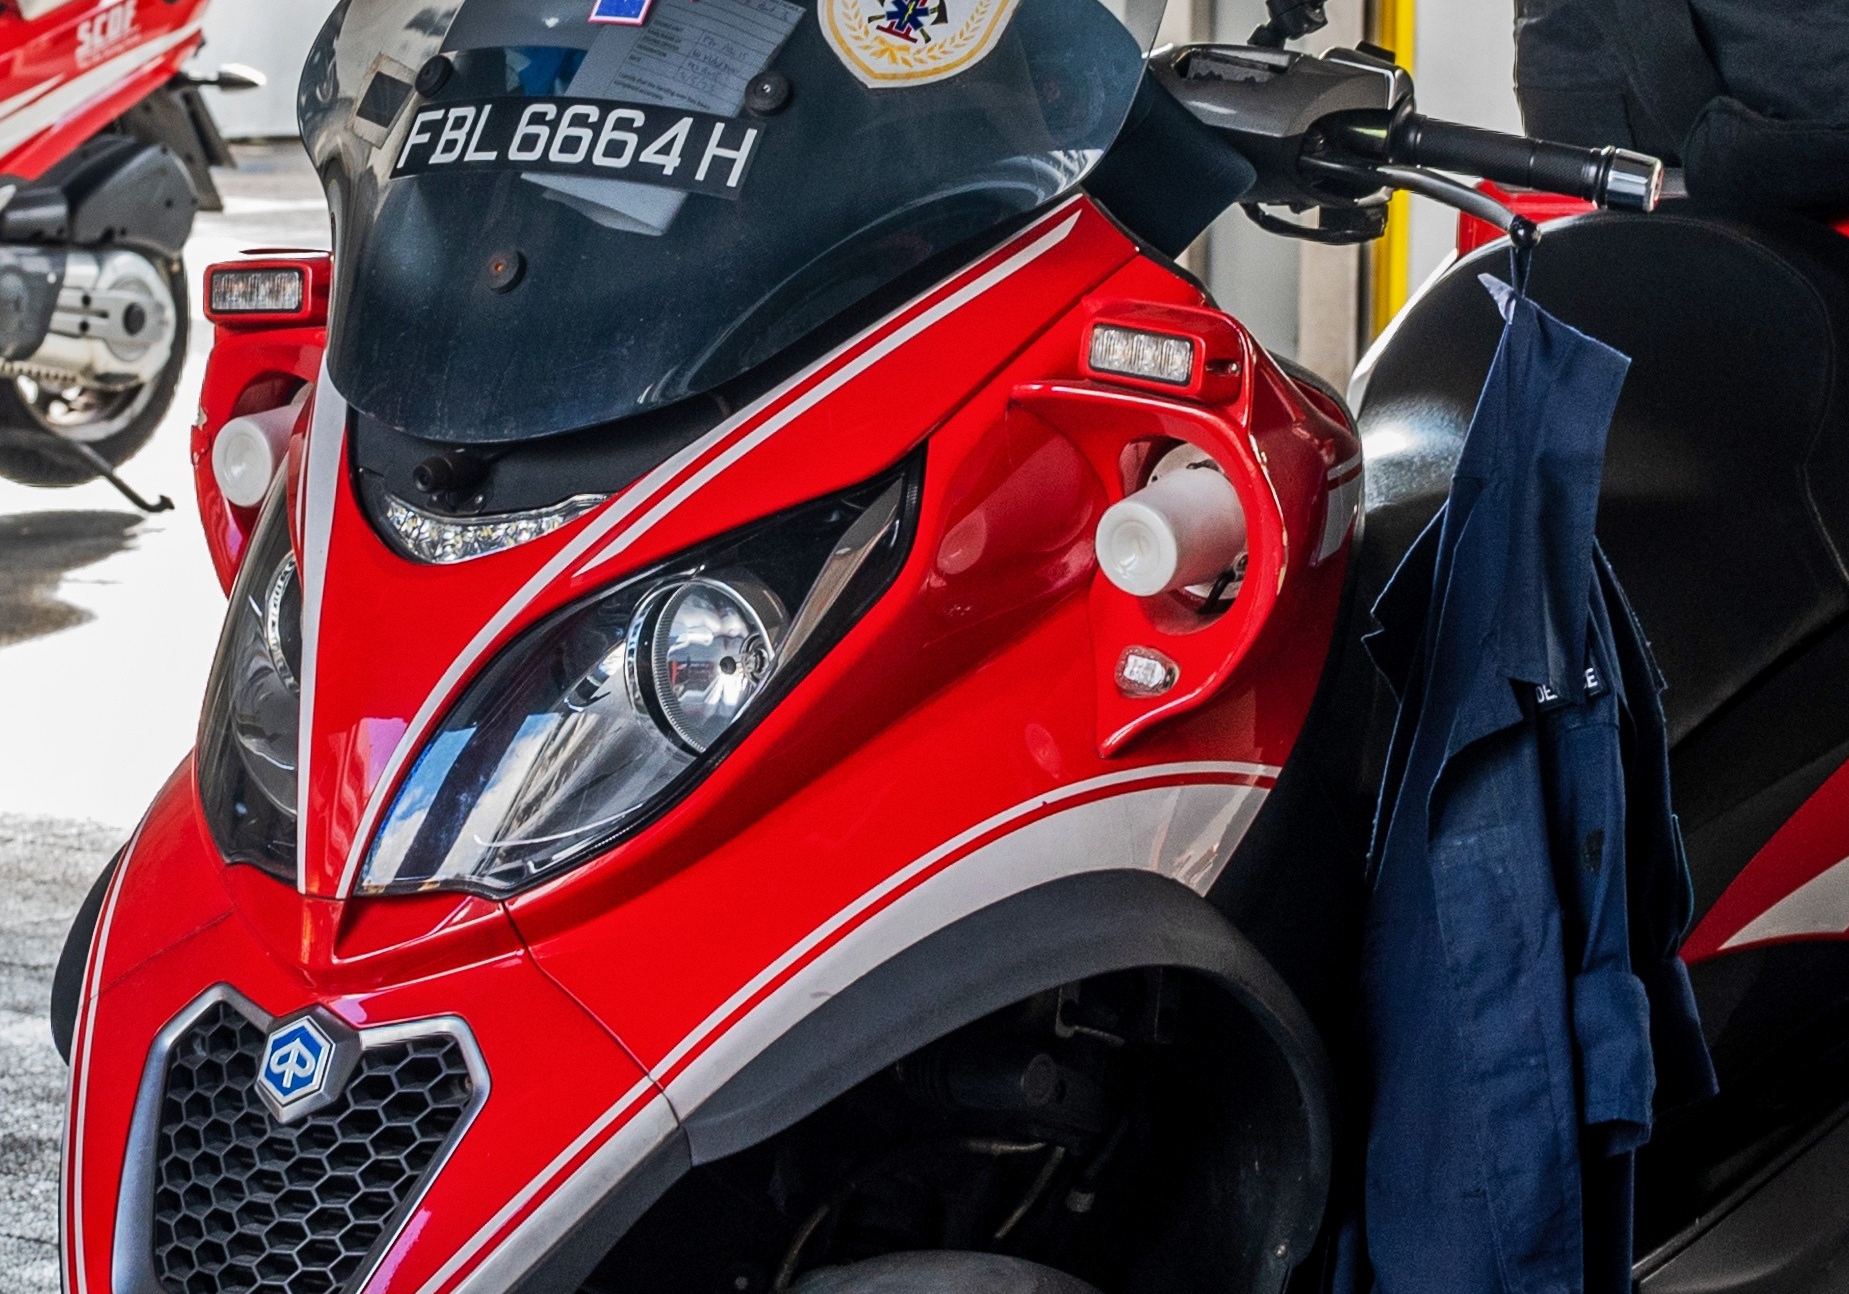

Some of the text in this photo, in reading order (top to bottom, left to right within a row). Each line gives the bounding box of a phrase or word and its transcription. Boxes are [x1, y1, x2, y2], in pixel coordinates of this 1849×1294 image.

[397, 103, 758, 188] FBL 6664 H
